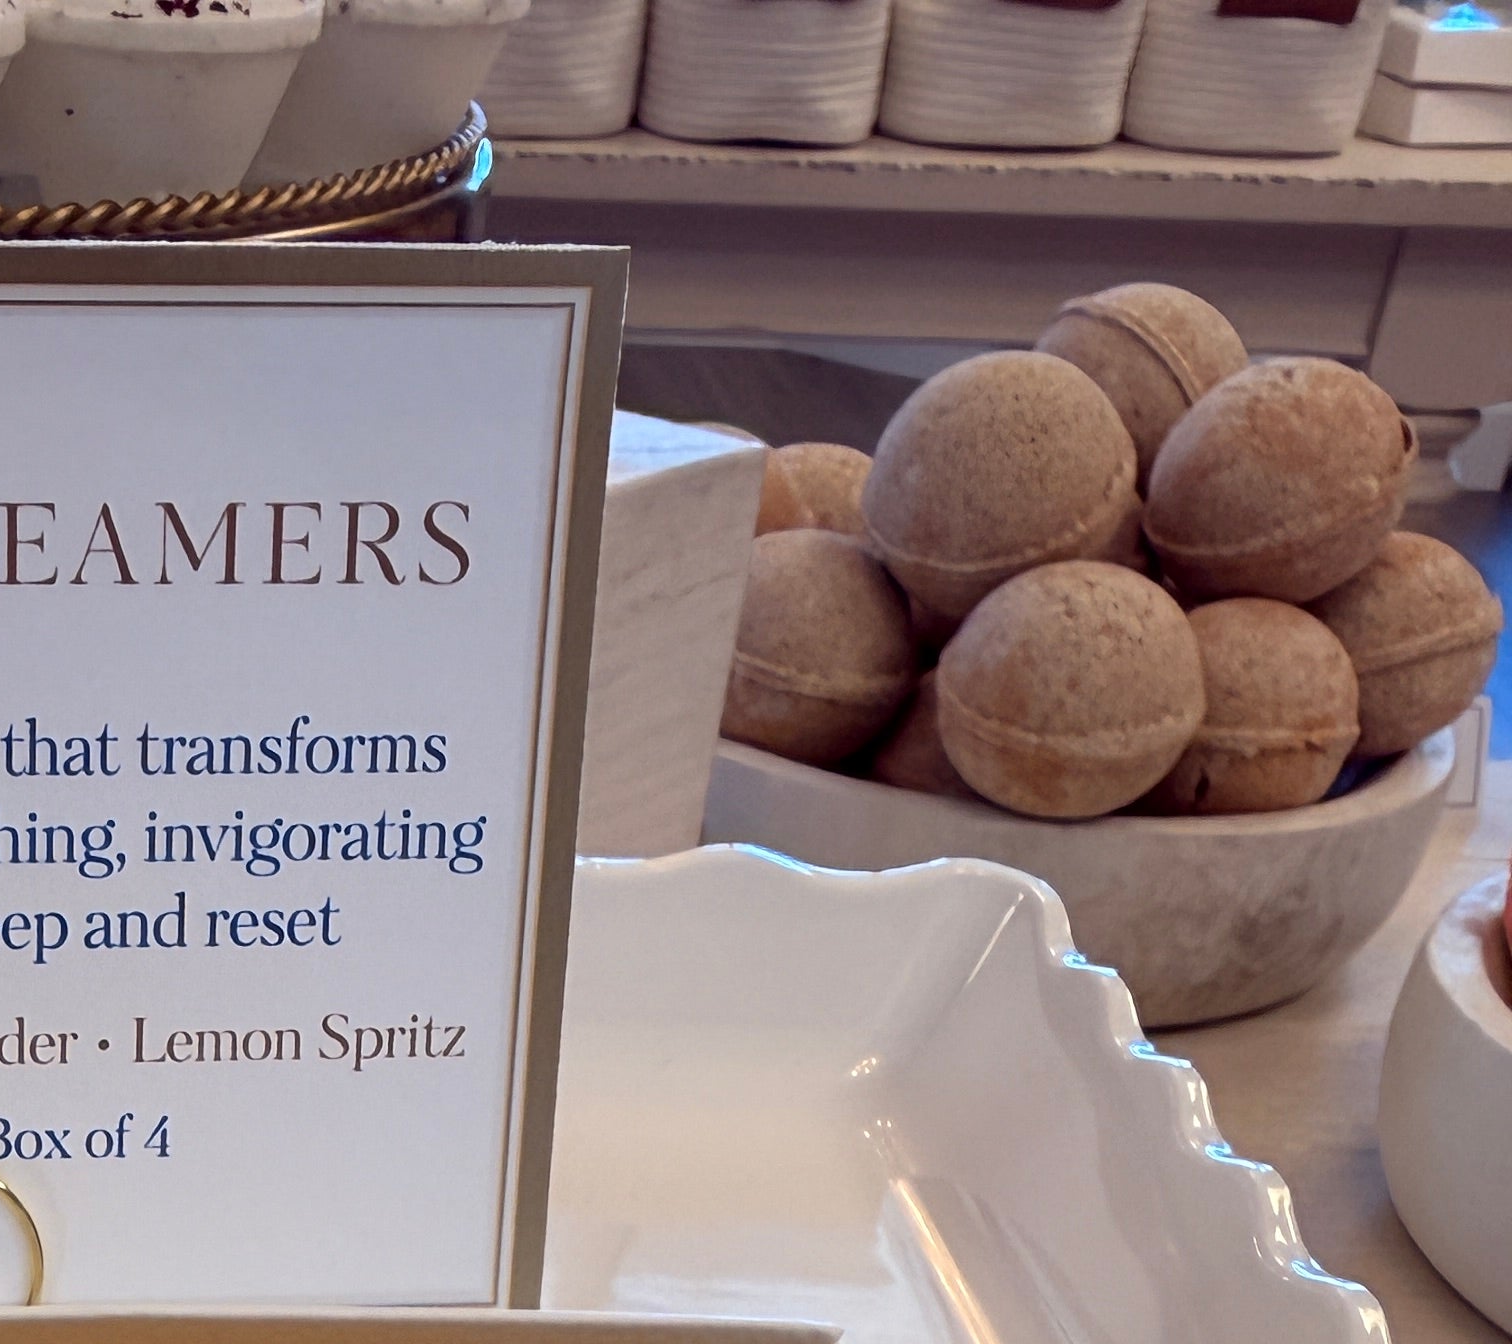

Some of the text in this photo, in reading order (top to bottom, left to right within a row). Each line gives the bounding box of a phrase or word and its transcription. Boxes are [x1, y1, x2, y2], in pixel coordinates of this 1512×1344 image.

[0, 717, 121, 777] that
[136, 715, 446, 775] transforms
[144, 809, 487, 877] invigorating
[84, 891, 187, 949] and
[204, 897, 341, 947] reset
[133, 1018, 301, 1063] Lemon
[319, 1014, 465, 1072] Spritz
[85, 1113, 134, 1158] of
[144, 1116, 170, 1157] 4
